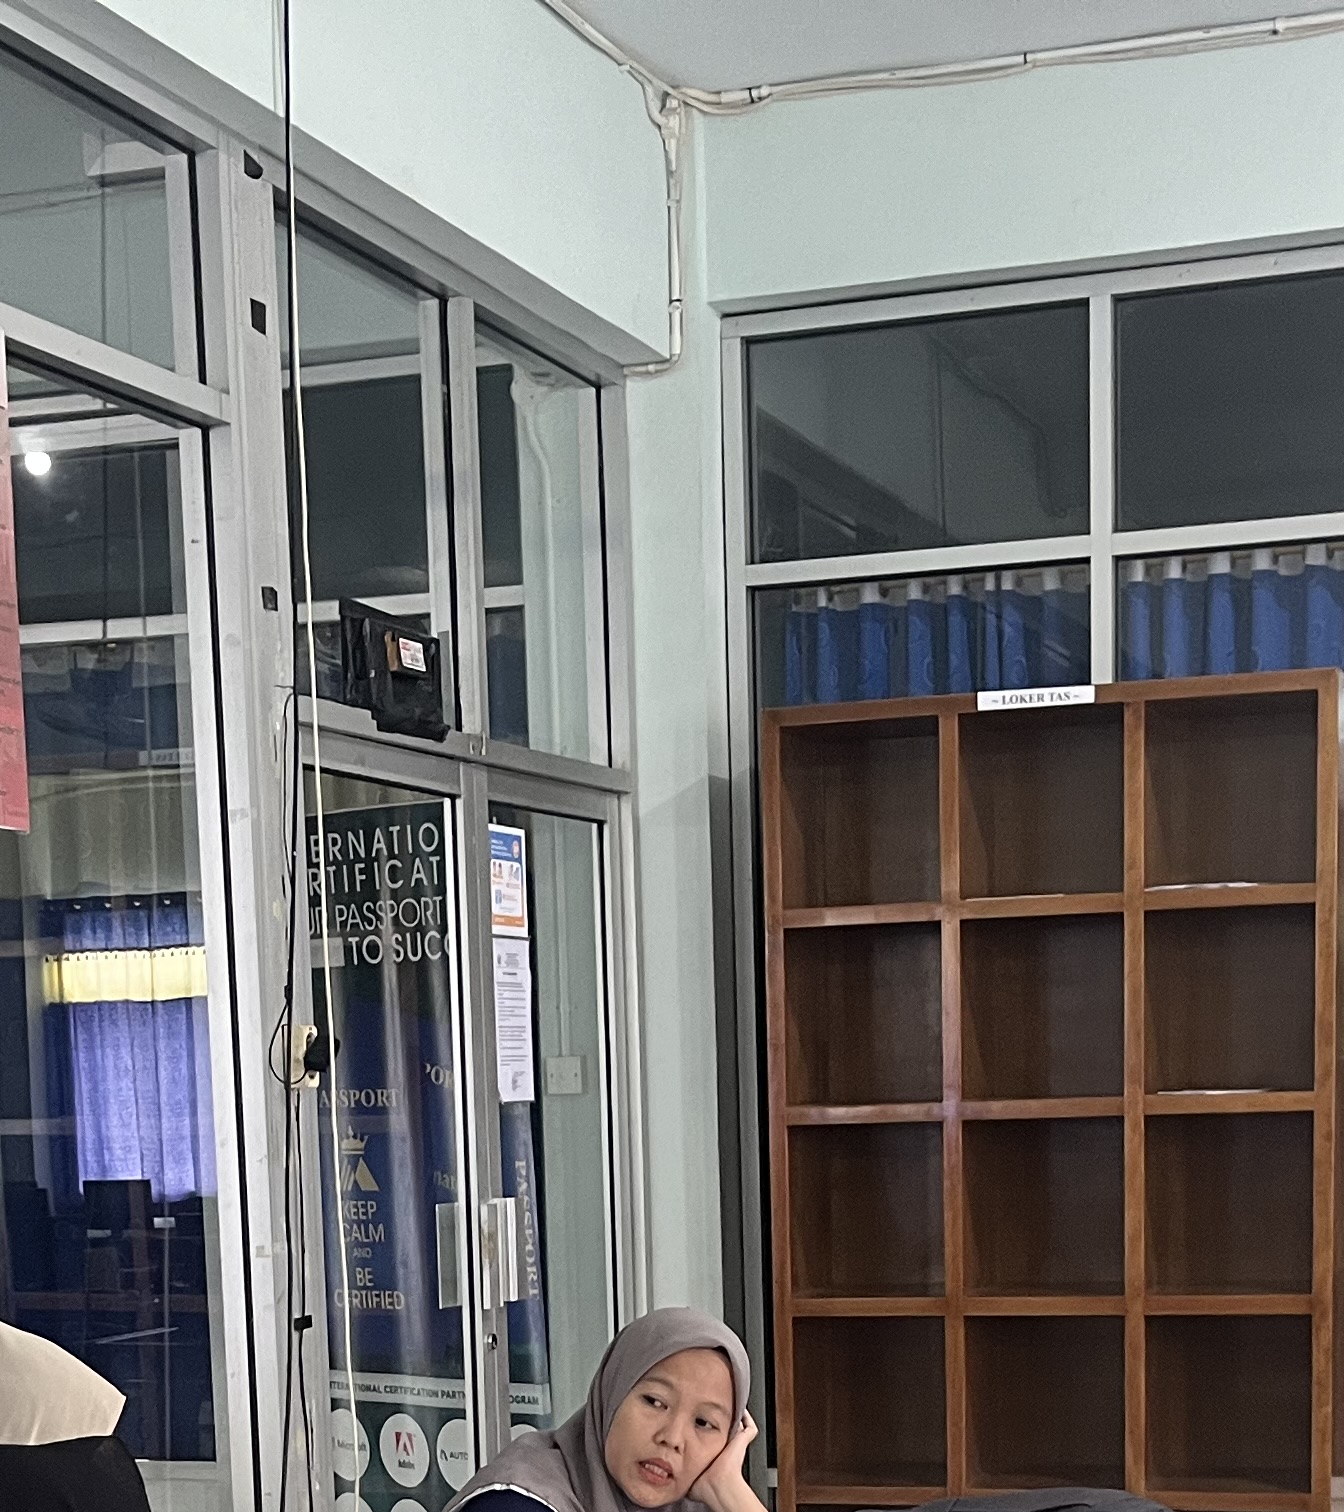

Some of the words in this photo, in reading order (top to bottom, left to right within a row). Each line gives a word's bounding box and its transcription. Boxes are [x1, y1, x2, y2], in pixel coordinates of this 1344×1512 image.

[1002, 693, 1045, 705] LOKER
[1049, 691, 1071, 702] TAS
[335, 896, 443, 932] PASSPORT
[348, 935, 383, 965] TO
[319, 1088, 400, 1108] ASPORT
[343, 1200, 377, 1220] KEEP
[353, 1247, 372, 1258] AND
[356, 1267, 375, 1287] BE
[384, 1385, 438, 1398] CERTIFICATION
